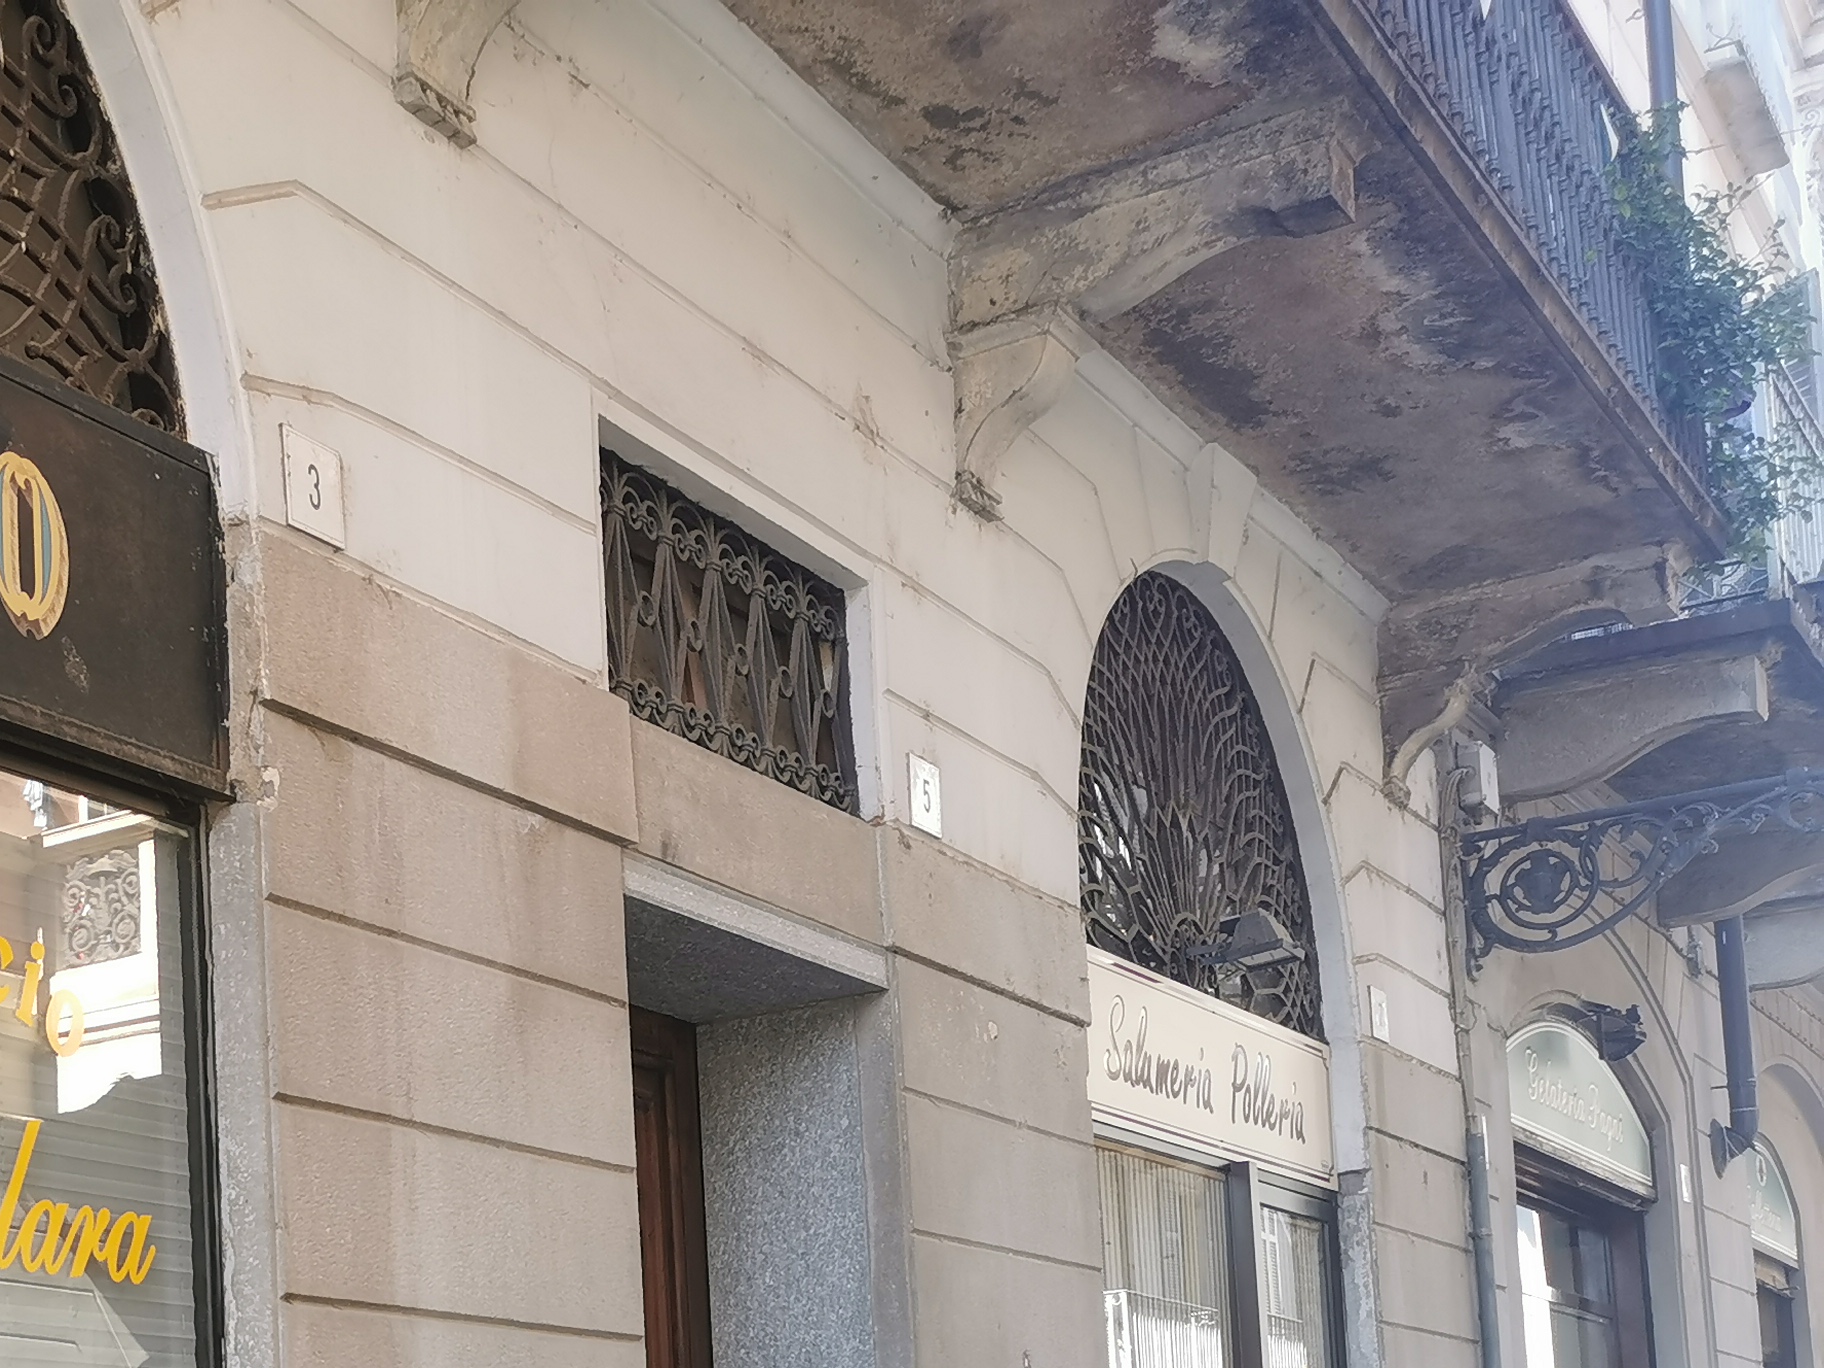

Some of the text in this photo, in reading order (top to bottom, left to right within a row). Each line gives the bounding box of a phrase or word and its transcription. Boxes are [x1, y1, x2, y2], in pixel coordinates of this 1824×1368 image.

[308, 463, 321, 511] 3
[923, 779, 931, 813] 5
[1104, 994, 1306, 1144] Salumeria Polleria
